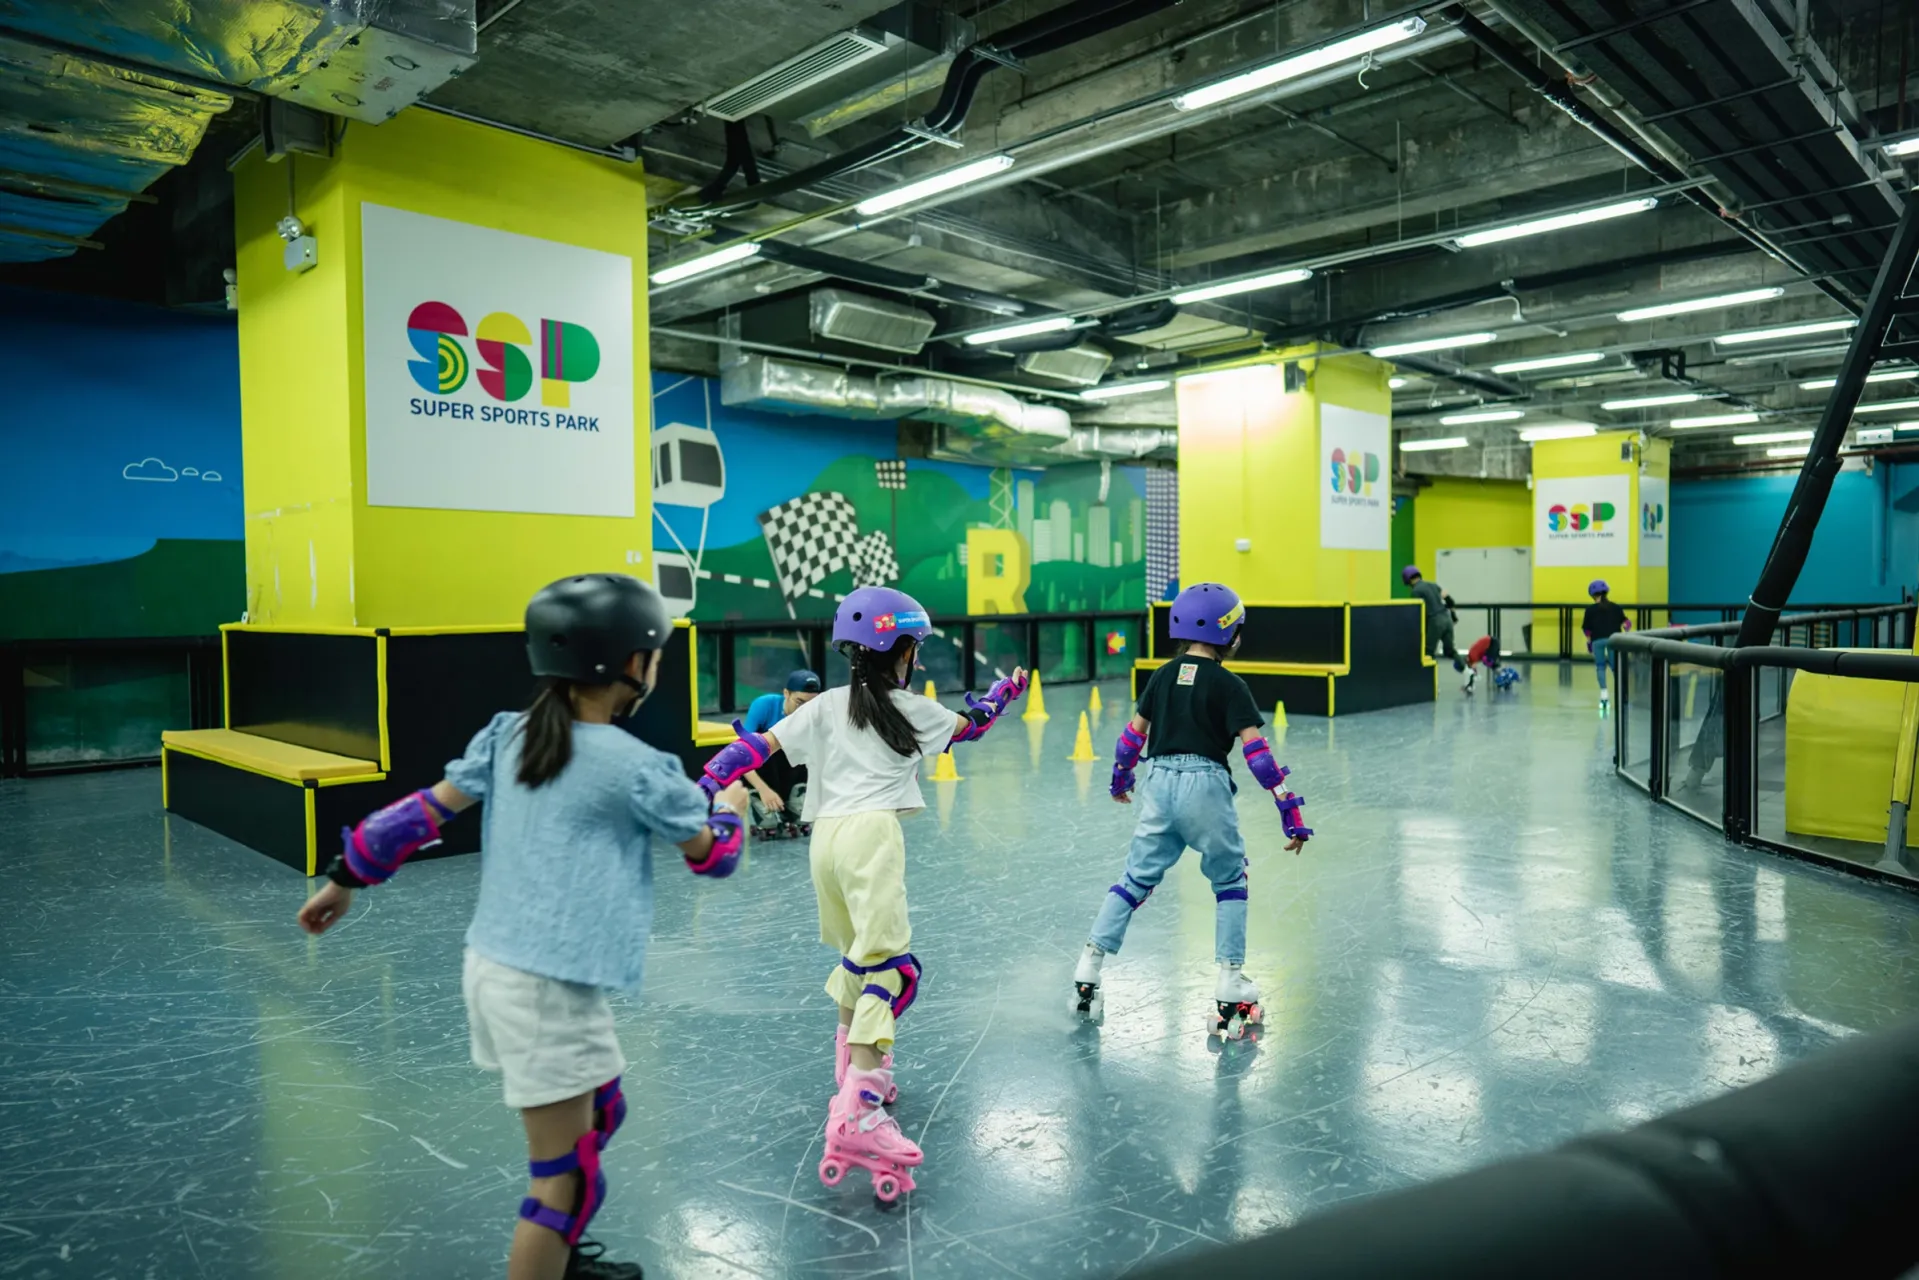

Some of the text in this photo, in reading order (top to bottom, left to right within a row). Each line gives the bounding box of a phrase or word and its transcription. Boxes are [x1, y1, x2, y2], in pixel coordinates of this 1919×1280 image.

[407, 301, 600, 408] SSP
[410, 398, 600, 432] SUPER SPORTS PARK
[1331, 447, 1380, 497] SSP
[1548, 502, 1616, 532] SSP
[967, 528, 1030, 615] R
